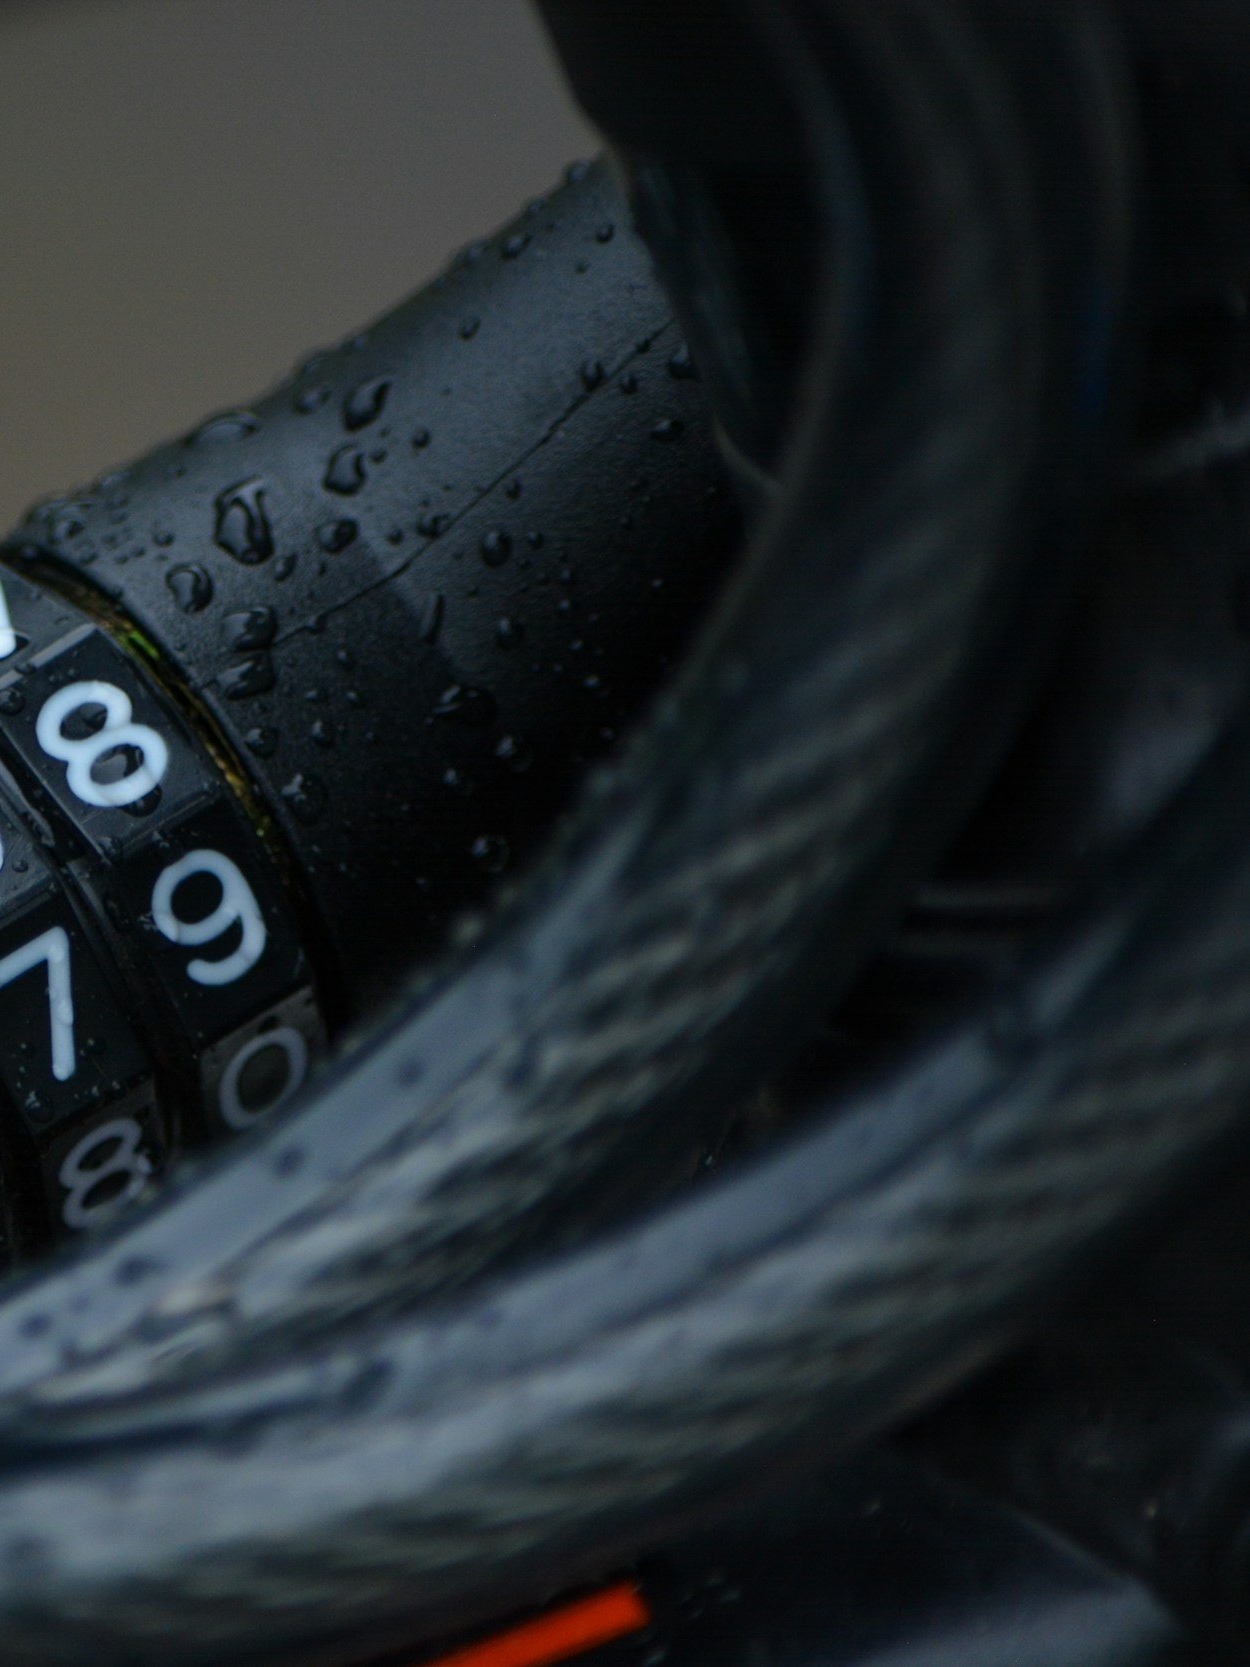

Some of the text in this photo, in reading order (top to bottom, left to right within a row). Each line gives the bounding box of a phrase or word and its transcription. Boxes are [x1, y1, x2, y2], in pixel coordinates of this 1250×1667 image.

[35, 679, 170, 808] 8
[151, 848, 267, 986] 9
[58, 1116, 152, 1230] 8
